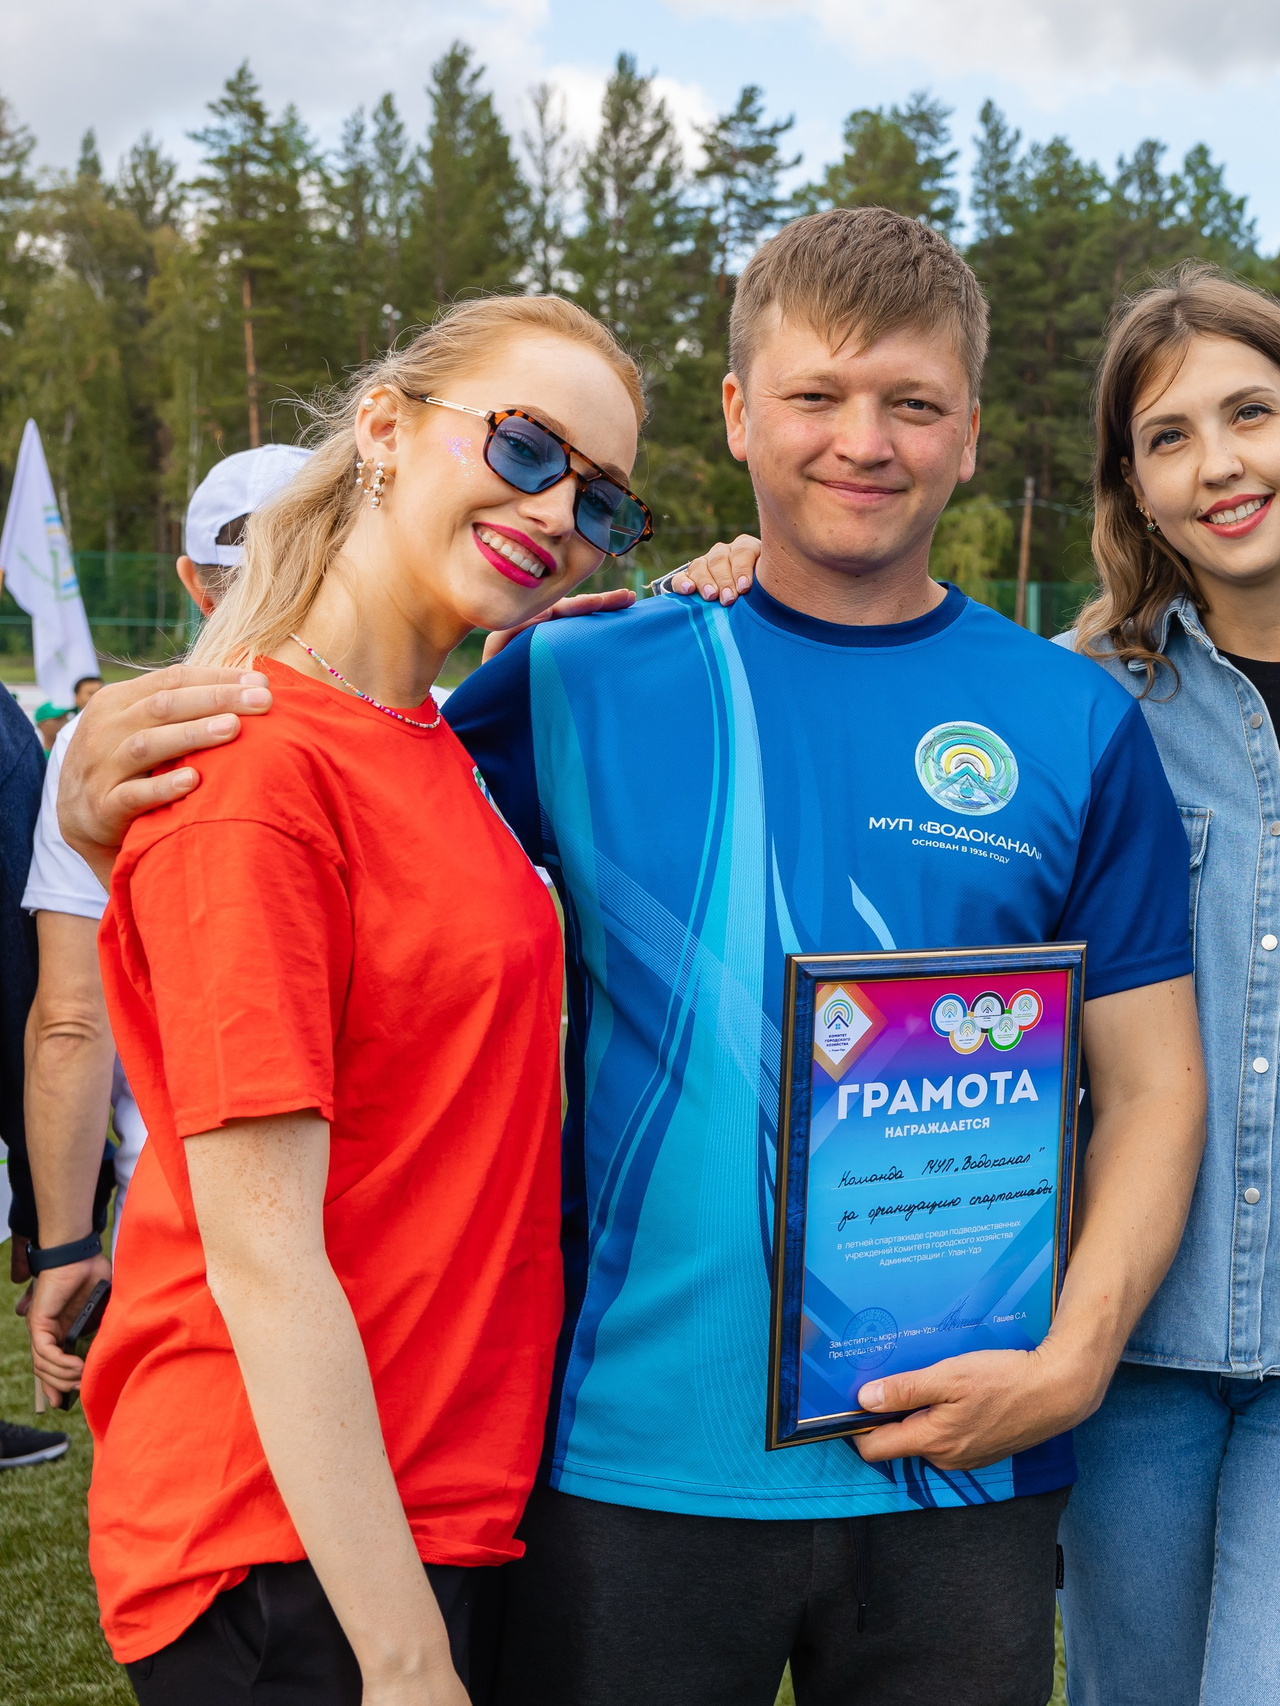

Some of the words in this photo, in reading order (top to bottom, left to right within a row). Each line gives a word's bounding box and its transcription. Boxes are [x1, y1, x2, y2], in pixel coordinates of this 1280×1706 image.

[869, 817, 913, 831] МУП
[912, 839, 959, 851] ОСНОВАН
[970, 847, 988, 857] 1936
[990, 852, 1010, 864] ГОДУ
[838, 1069, 1039, 1120] ГРАМОТА
[885, 1117, 990, 1139] НАГРАЖДАЕТСЯ
[837, 1165, 905, 1188] Команда
[837, 1209, 859, 1231] за
[868, 1197, 961, 1224] организацию
[969, 1179, 1053, 1210] спартакиады
[845, 1237, 873, 1249] летней
[874, 1233, 924, 1247] спартакиаде
[925, 1230, 949, 1243] среди
[949, 1219, 1021, 1235] подведомственных
[845, 1246, 893, 1262] учреждений
[893, 1242, 930, 1254] Комитета
[931, 1237, 975, 1251] городского
[976, 1231, 1013, 1244] хозяйства
[879, 1252, 940, 1266] Администрации
[947, 1246, 982, 1258] Улан-Удэ
[993, 1314, 1014, 1323] Гашев
